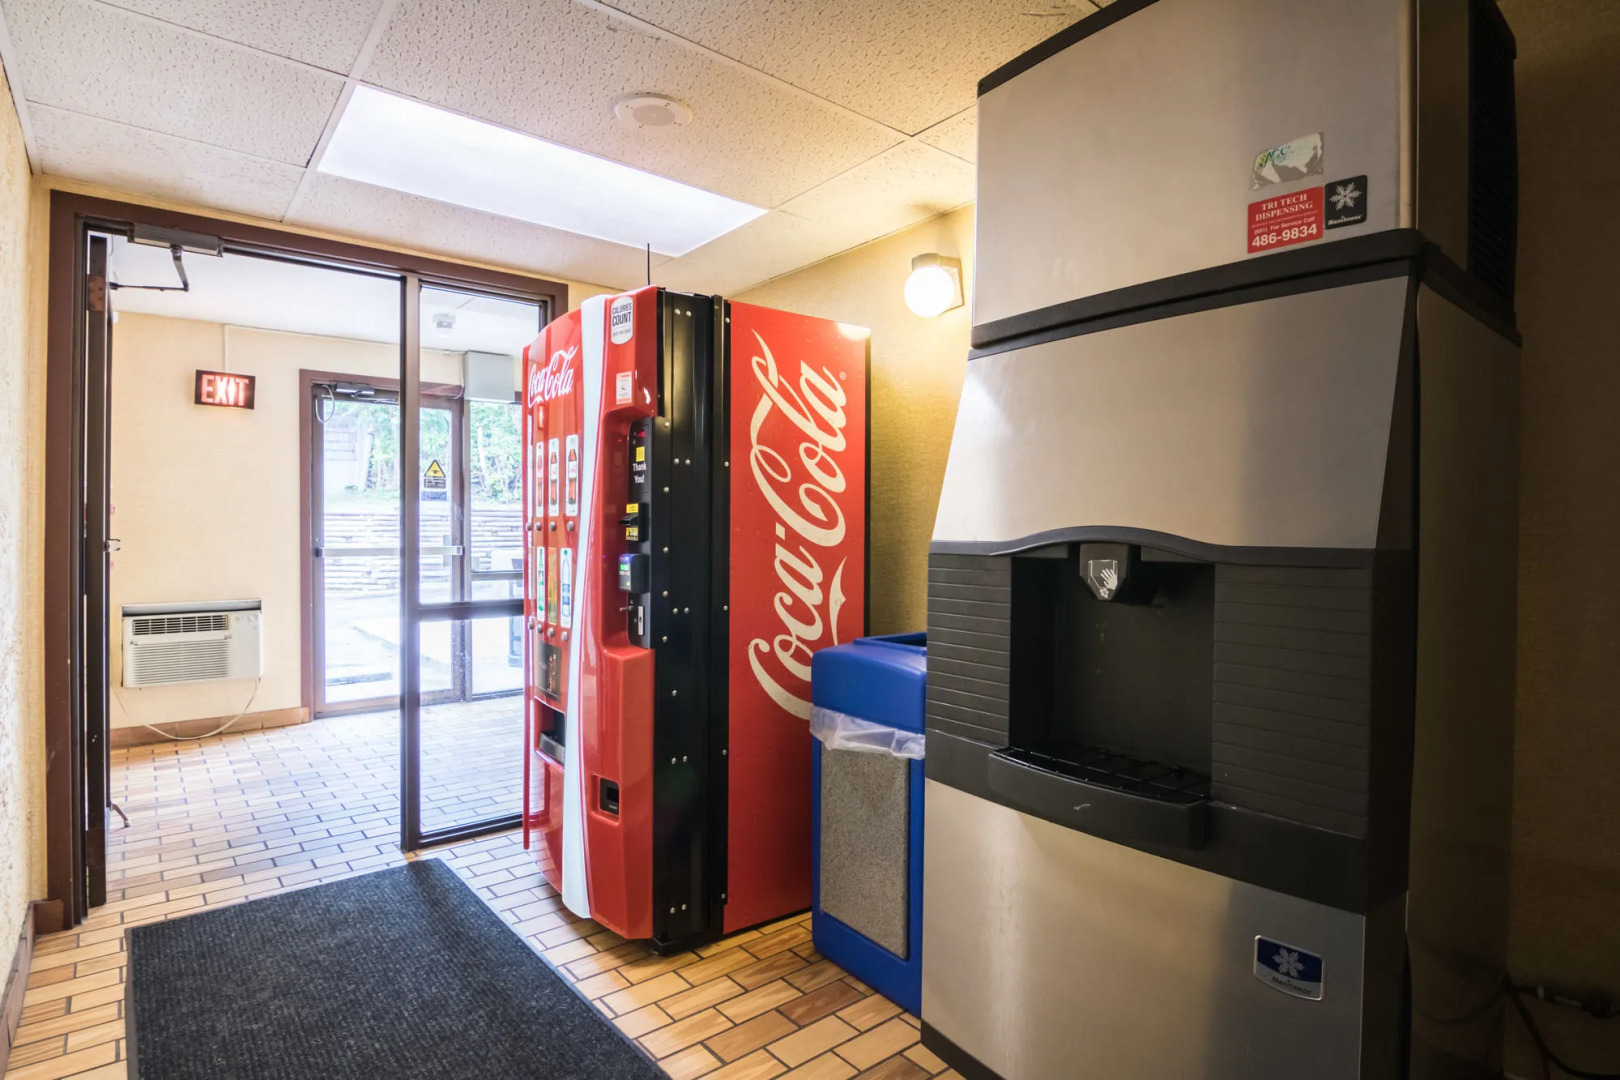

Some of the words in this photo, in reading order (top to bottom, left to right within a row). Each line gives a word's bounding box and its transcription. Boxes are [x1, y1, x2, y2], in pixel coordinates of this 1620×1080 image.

[1255, 201, 1313, 221] DISPENSING
[1262, 200, 1278, 211] TRI
[1280, 193, 1307, 206] TECH
[1281, 219, 1302, 228] Service
[1252, 223, 1318, 247] 486-9834
[612, 303, 632, 315] CALORIES
[612, 311, 632, 327] COUNT
[528, 345, 579, 408] Coca-Cola
[201, 373, 250, 407] EXIT
[632, 462, 647, 472] Thank
[634, 474, 645, 484] You!
[748, 328, 847, 721] Coca-Cola
[1271, 976, 1313, 996] Manitowoc
